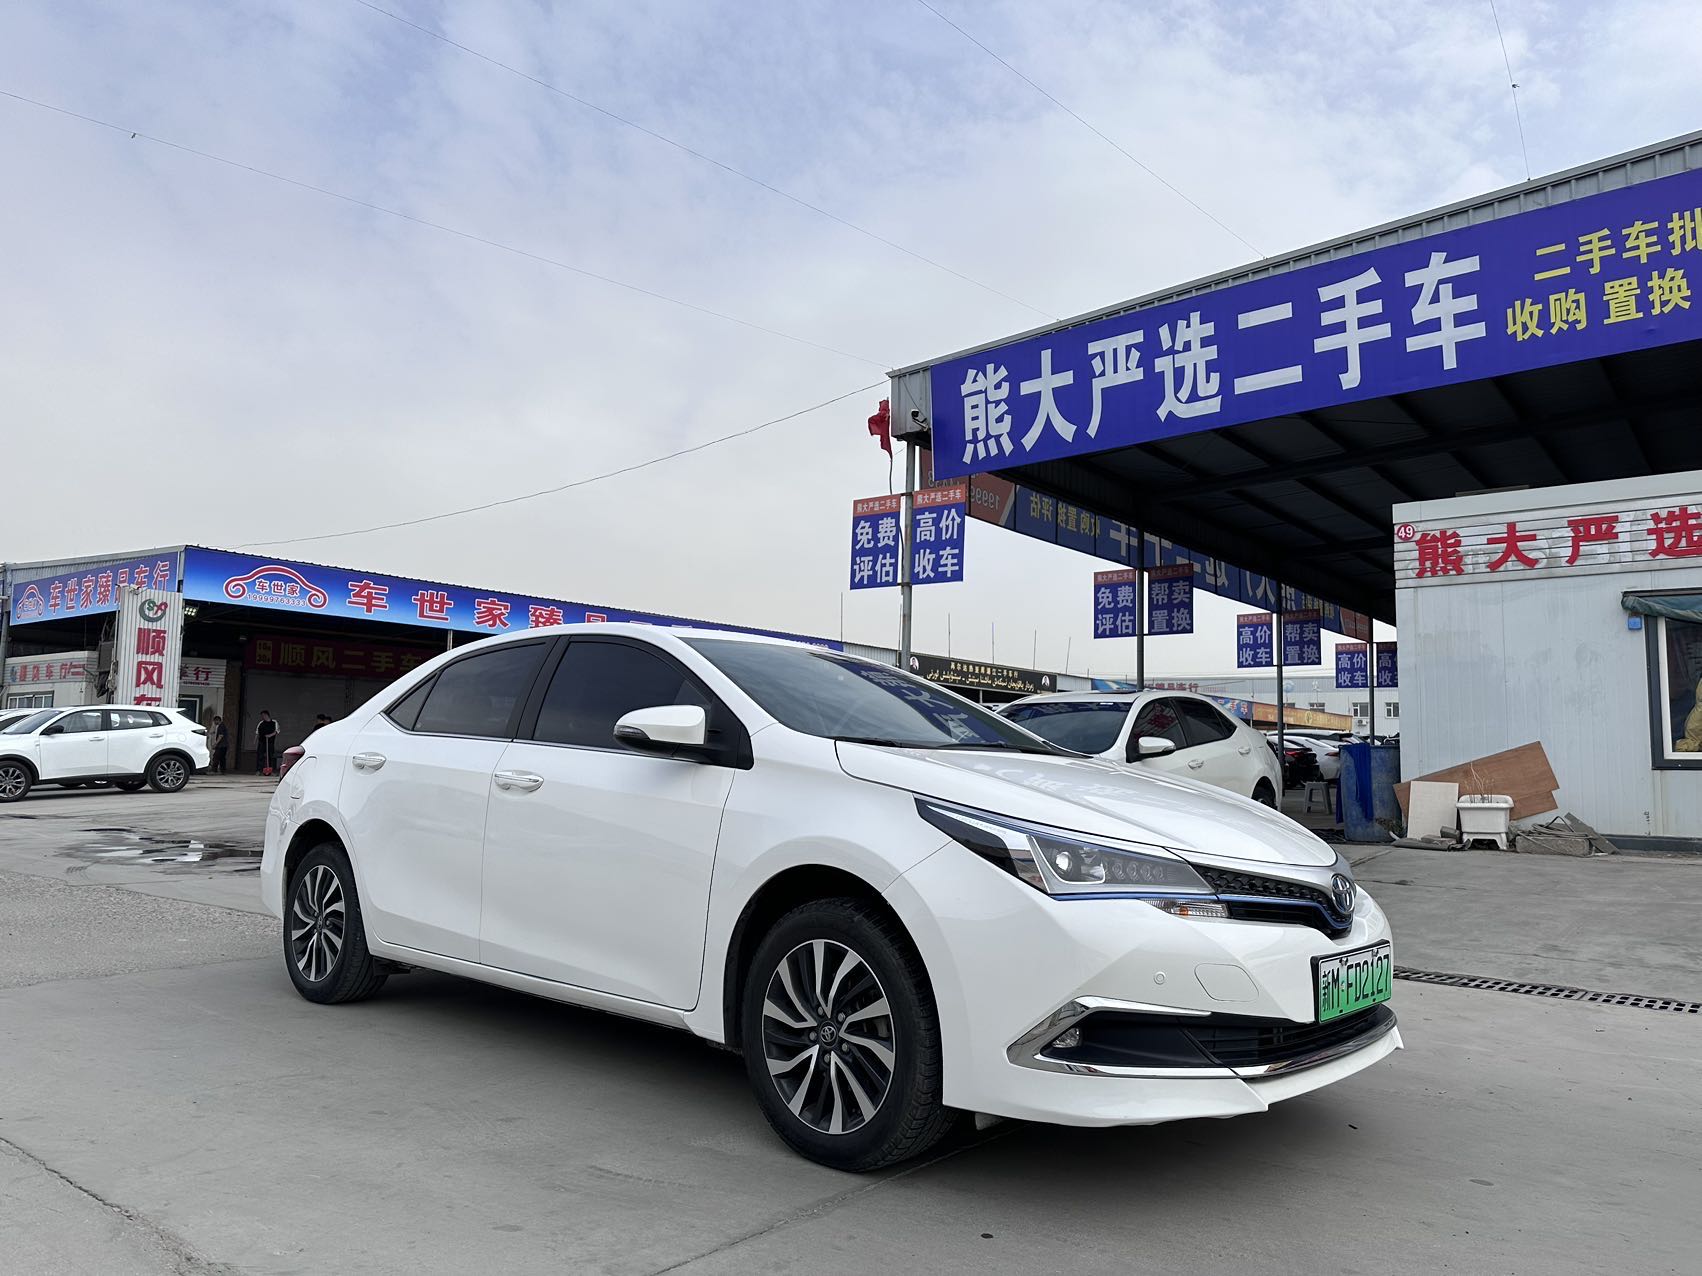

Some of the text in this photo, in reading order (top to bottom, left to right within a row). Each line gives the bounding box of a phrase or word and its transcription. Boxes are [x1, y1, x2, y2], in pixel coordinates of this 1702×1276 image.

[1534, 208, 1702, 280] 二手车批
[1506, 268, 1691, 341] 收购 置换
[961, 252, 1486, 464] 熊大严选二手车
[917, 489, 962, 505] 熊大严选二手车
[855, 517, 897, 550] 免费
[916, 508, 961, 543] 高价
[1398, 526, 1415, 539] 49
[1415, 505, 1702, 578] 熊大严选
[853, 553, 895, 585] 评估
[914, 547, 960, 579] 收车
[255, 579, 299, 596] 车世家
[1097, 585, 1134, 609] 免费
[1151, 580, 1190, 605] 帮卖
[1096, 612, 1134, 635] 评估
[1151, 607, 1191, 632] 置换
[1239, 625, 1271, 644] 高价
[1285, 622, 1318, 642] 帮卖
[1239, 647, 1271, 665] 收车
[1285, 644, 1319, 664] 置换
[1338, 652, 1366, 669] 高价
[1338, 670, 1366, 686] 收车
